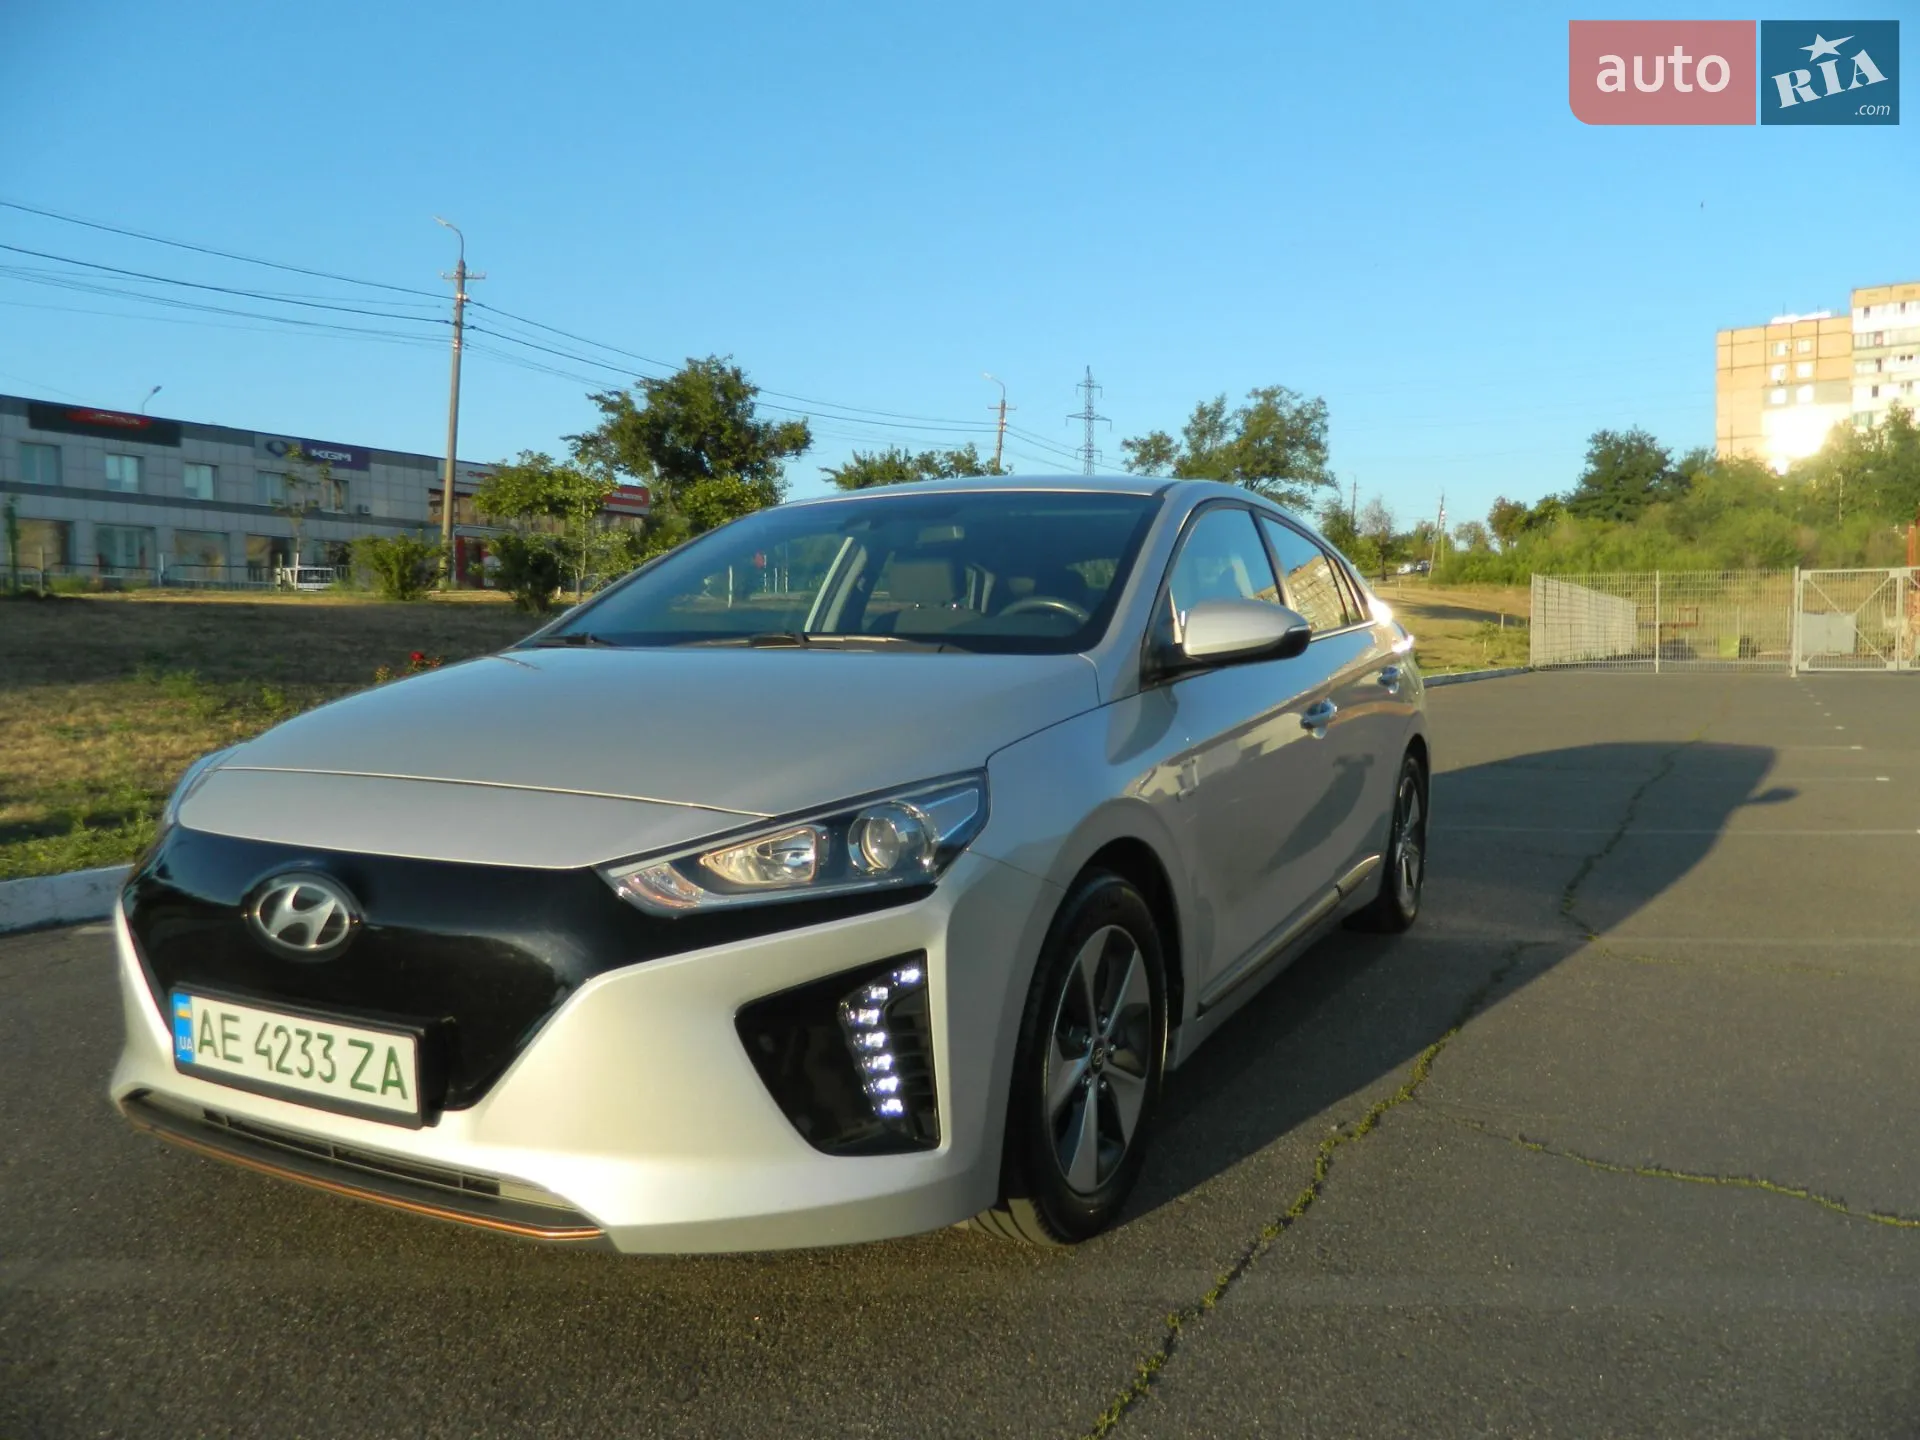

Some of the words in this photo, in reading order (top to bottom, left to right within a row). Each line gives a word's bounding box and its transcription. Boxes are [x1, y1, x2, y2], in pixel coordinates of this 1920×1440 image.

[310, 448, 352, 462] KGM
[179, 1035, 194, 1053] UA
[198, 1009, 243, 1064] AE
[254, 1022, 337, 1084] 4233
[348, 1038, 408, 1100] ZA
